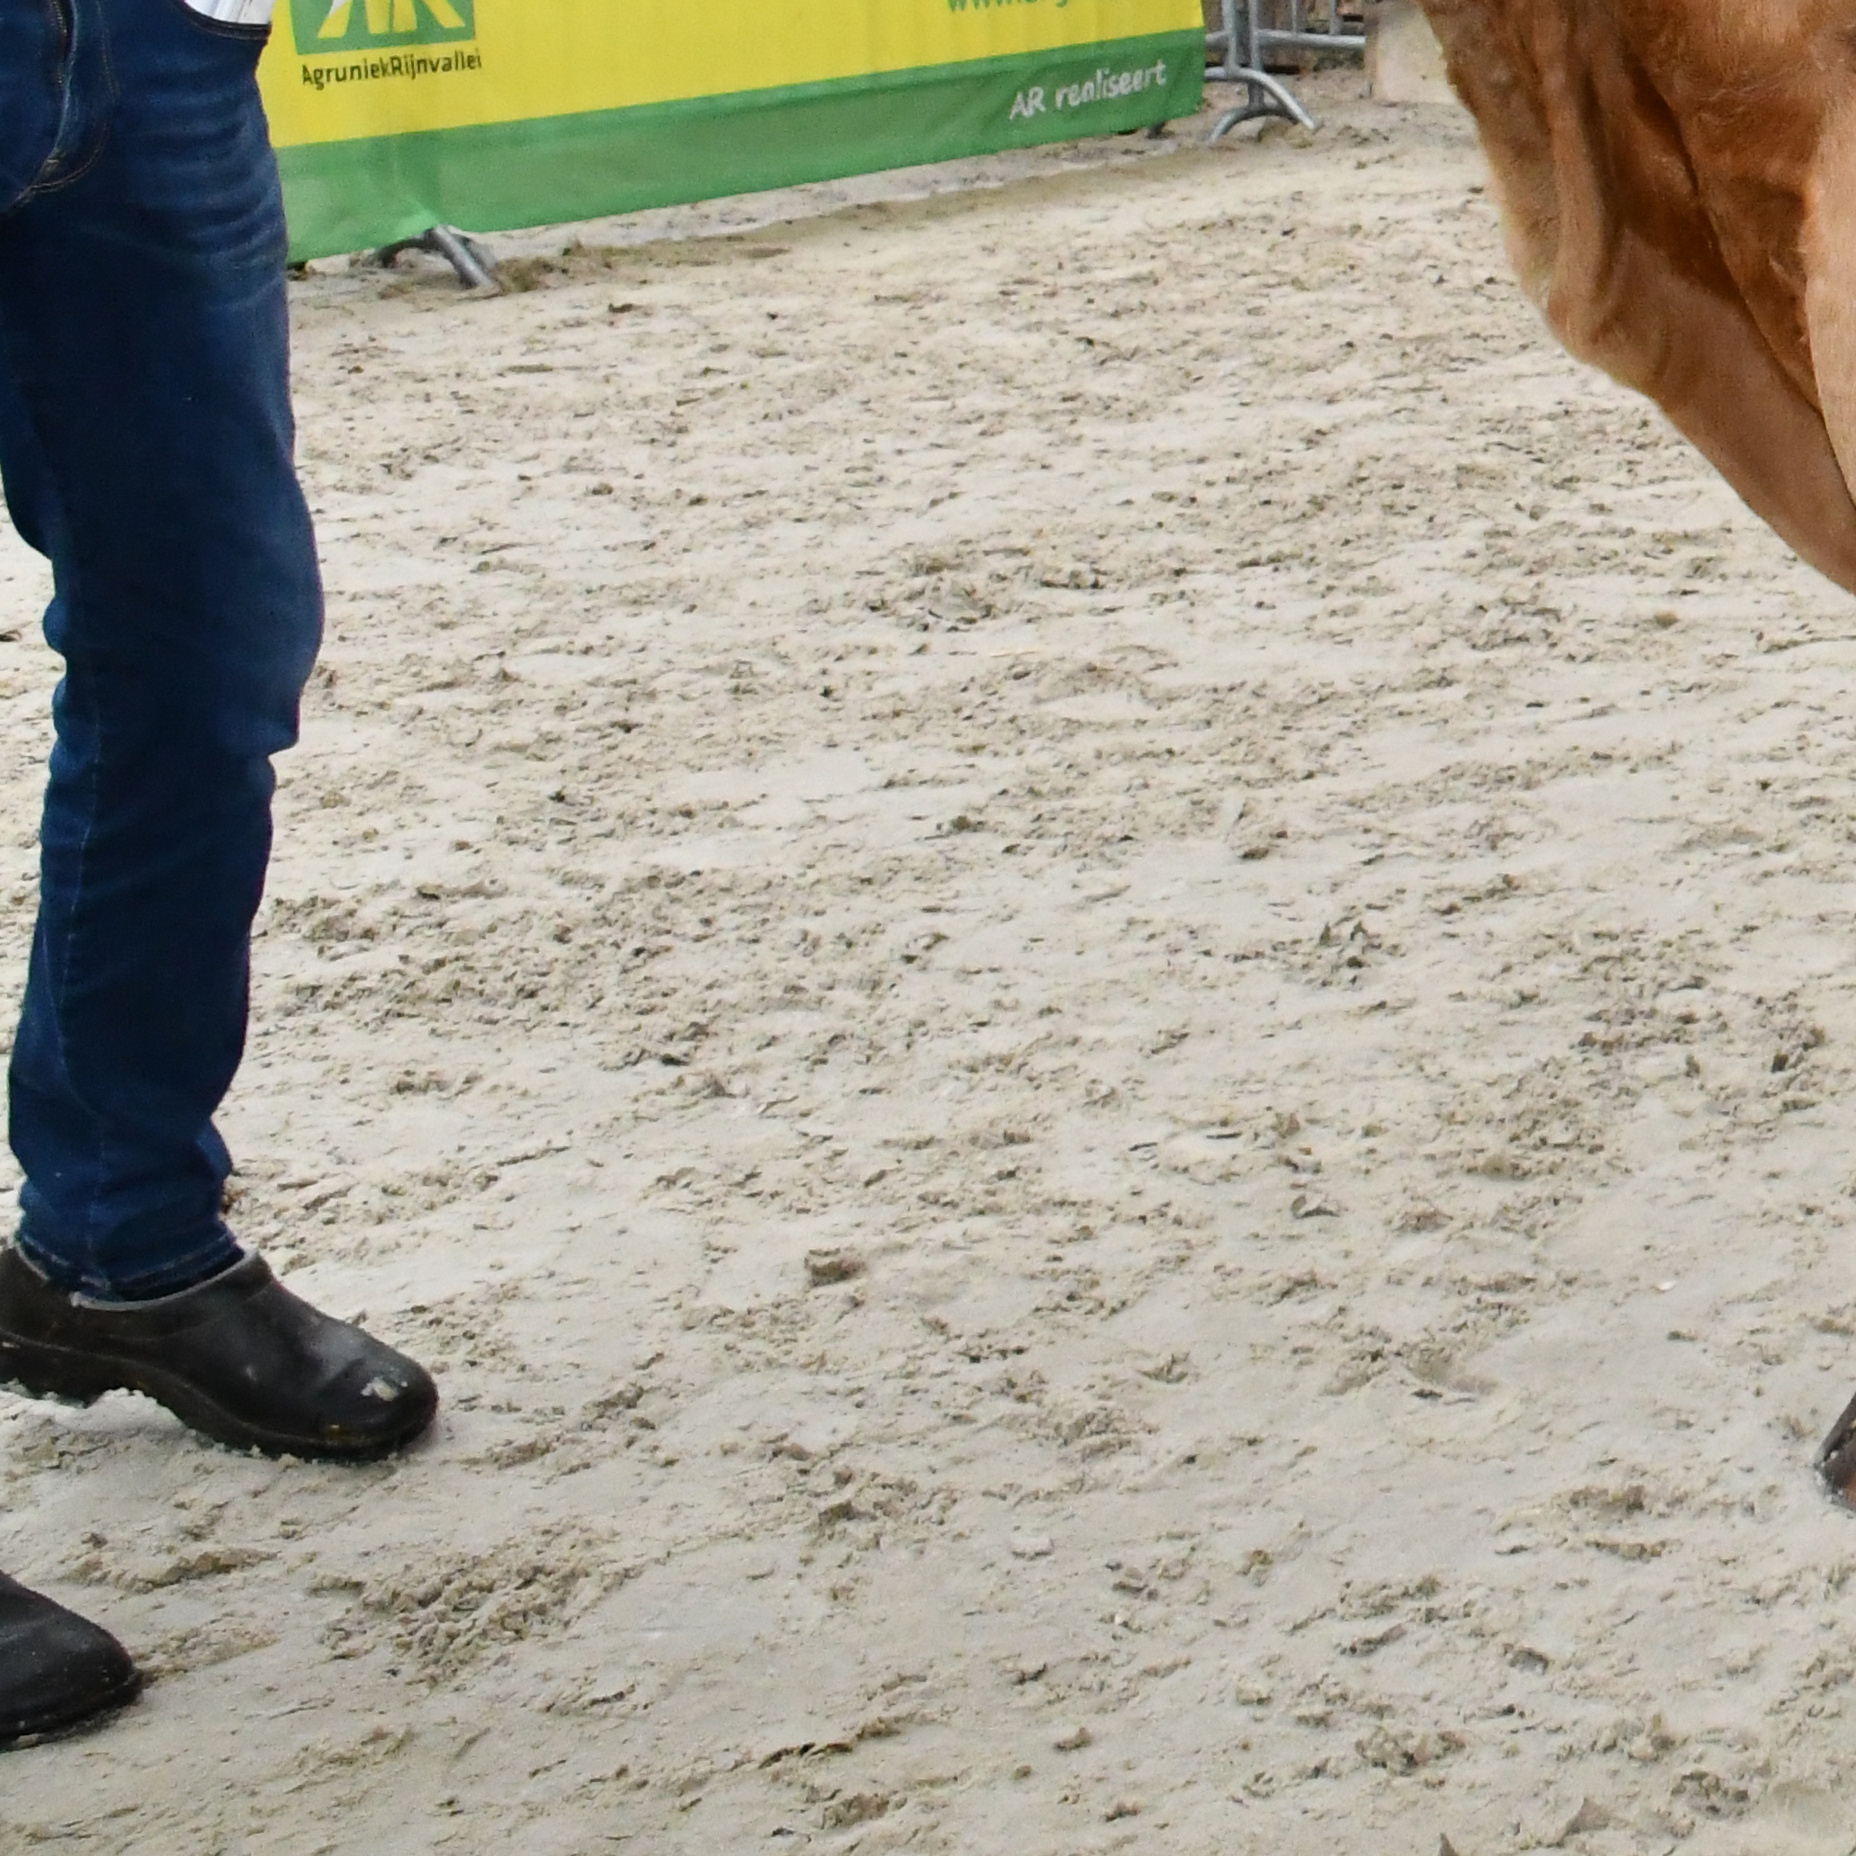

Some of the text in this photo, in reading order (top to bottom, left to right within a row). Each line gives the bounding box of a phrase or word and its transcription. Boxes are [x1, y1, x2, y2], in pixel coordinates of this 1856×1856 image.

[302, 48, 482, 90] AgruniekRijnvallei
[1009, 58, 1167, 121] AR realiseert
